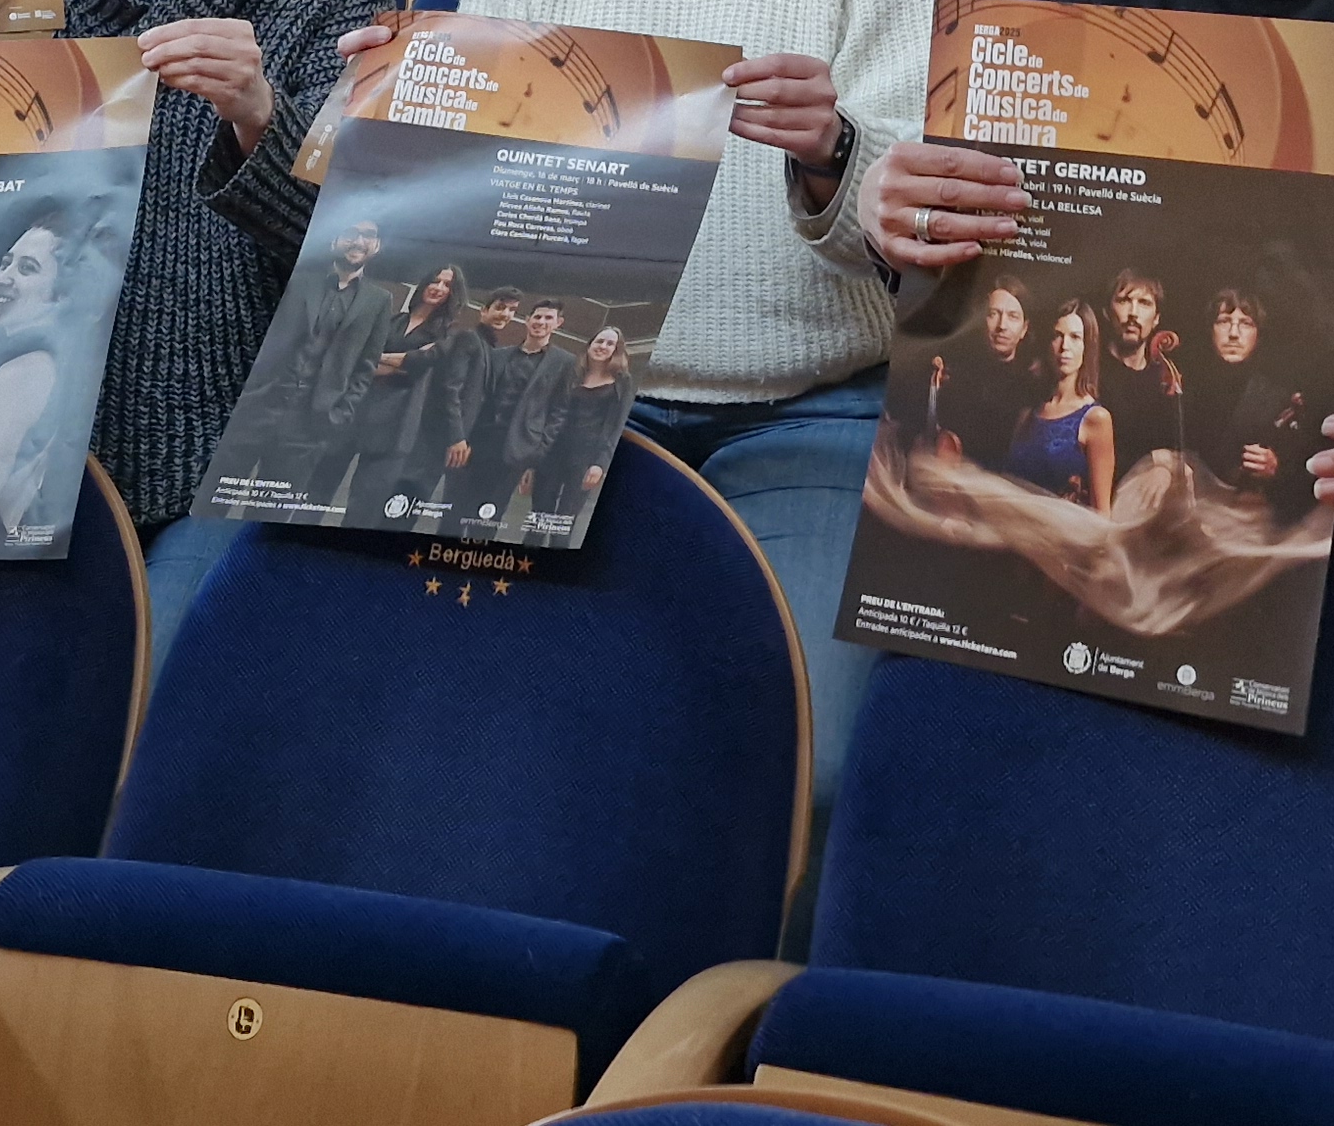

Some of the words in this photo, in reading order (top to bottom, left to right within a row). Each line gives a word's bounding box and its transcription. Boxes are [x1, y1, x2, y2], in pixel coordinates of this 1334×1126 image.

[974, 24, 1021, 37] BERGA2025
[404, 40, 455, 64] Cicle
[453, 54, 466, 66] de
[971, 36, 1028, 67] Cicle
[1028, 54, 1043, 68] de
[398, 59, 488, 90] Concerts
[487, 80, 499, 92] de
[969, 62, 1075, 97] Concerts
[1073, 83, 1090, 98] de
[392, 79, 467, 109] Música
[466, 99, 479, 111] de
[965, 88, 1053, 122] Música
[1052, 108, 1068, 123] de
[387, 100, 466, 131] Cambra
[963, 114, 1057, 148] Cambra
[497, 148, 565, 168] QUINTET
[567, 158, 630, 176] SENART
[1055, 162, 1147, 186] GERHARD
[490, 178, 521, 190] VIATGE
[522, 181, 535, 191] EN
[536, 183, 547, 192] EL
[549, 185, 579, 196] TEMPS
[548, 172, 558, 181] de
[596, 178, 602, 186] h
[608, 178, 638, 190] Pavelló
[639, 182, 650, 191] de
[651, 183, 679, 194] Suècia
[1064, 184, 1071, 194] h
[1078, 187, 1113, 200] Pavelló
[1115, 190, 1128, 201] de
[1129, 191, 1162, 204] Suècia
[1041, 200, 1055, 211] LA
[1057, 202, 1102, 217] BELLESA
[428, 542, 516, 571] Berguedà
[860, 594, 883, 607] PREU
[883, 598, 895, 609] DE
